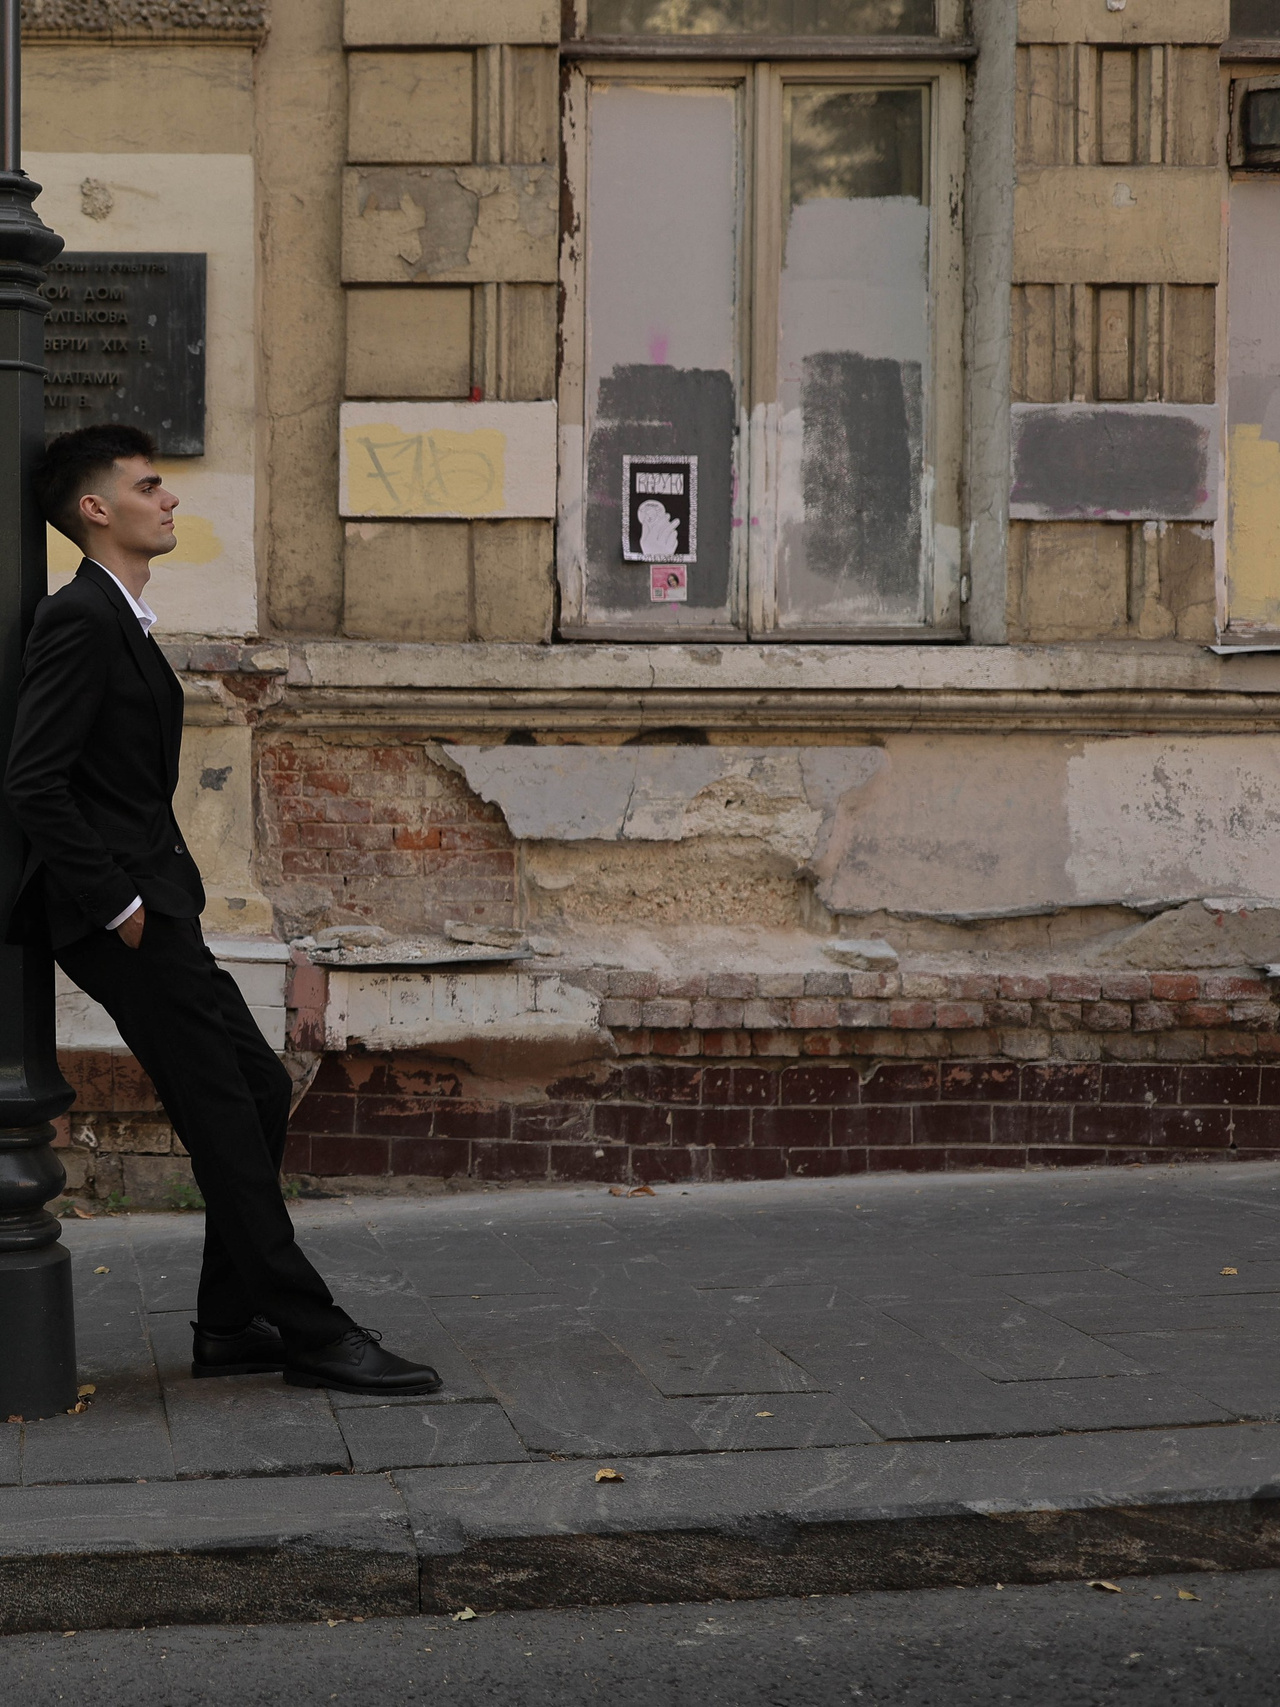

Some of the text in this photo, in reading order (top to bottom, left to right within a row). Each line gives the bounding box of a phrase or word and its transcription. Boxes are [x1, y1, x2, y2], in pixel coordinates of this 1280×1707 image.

[84, 287, 124, 302] ДОМ
[43, 309, 129, 323] АЛТЫКОВА
[43, 338, 89, 351] ВЕРТИ
[43, 371, 120, 384] АЛАТАМИ
